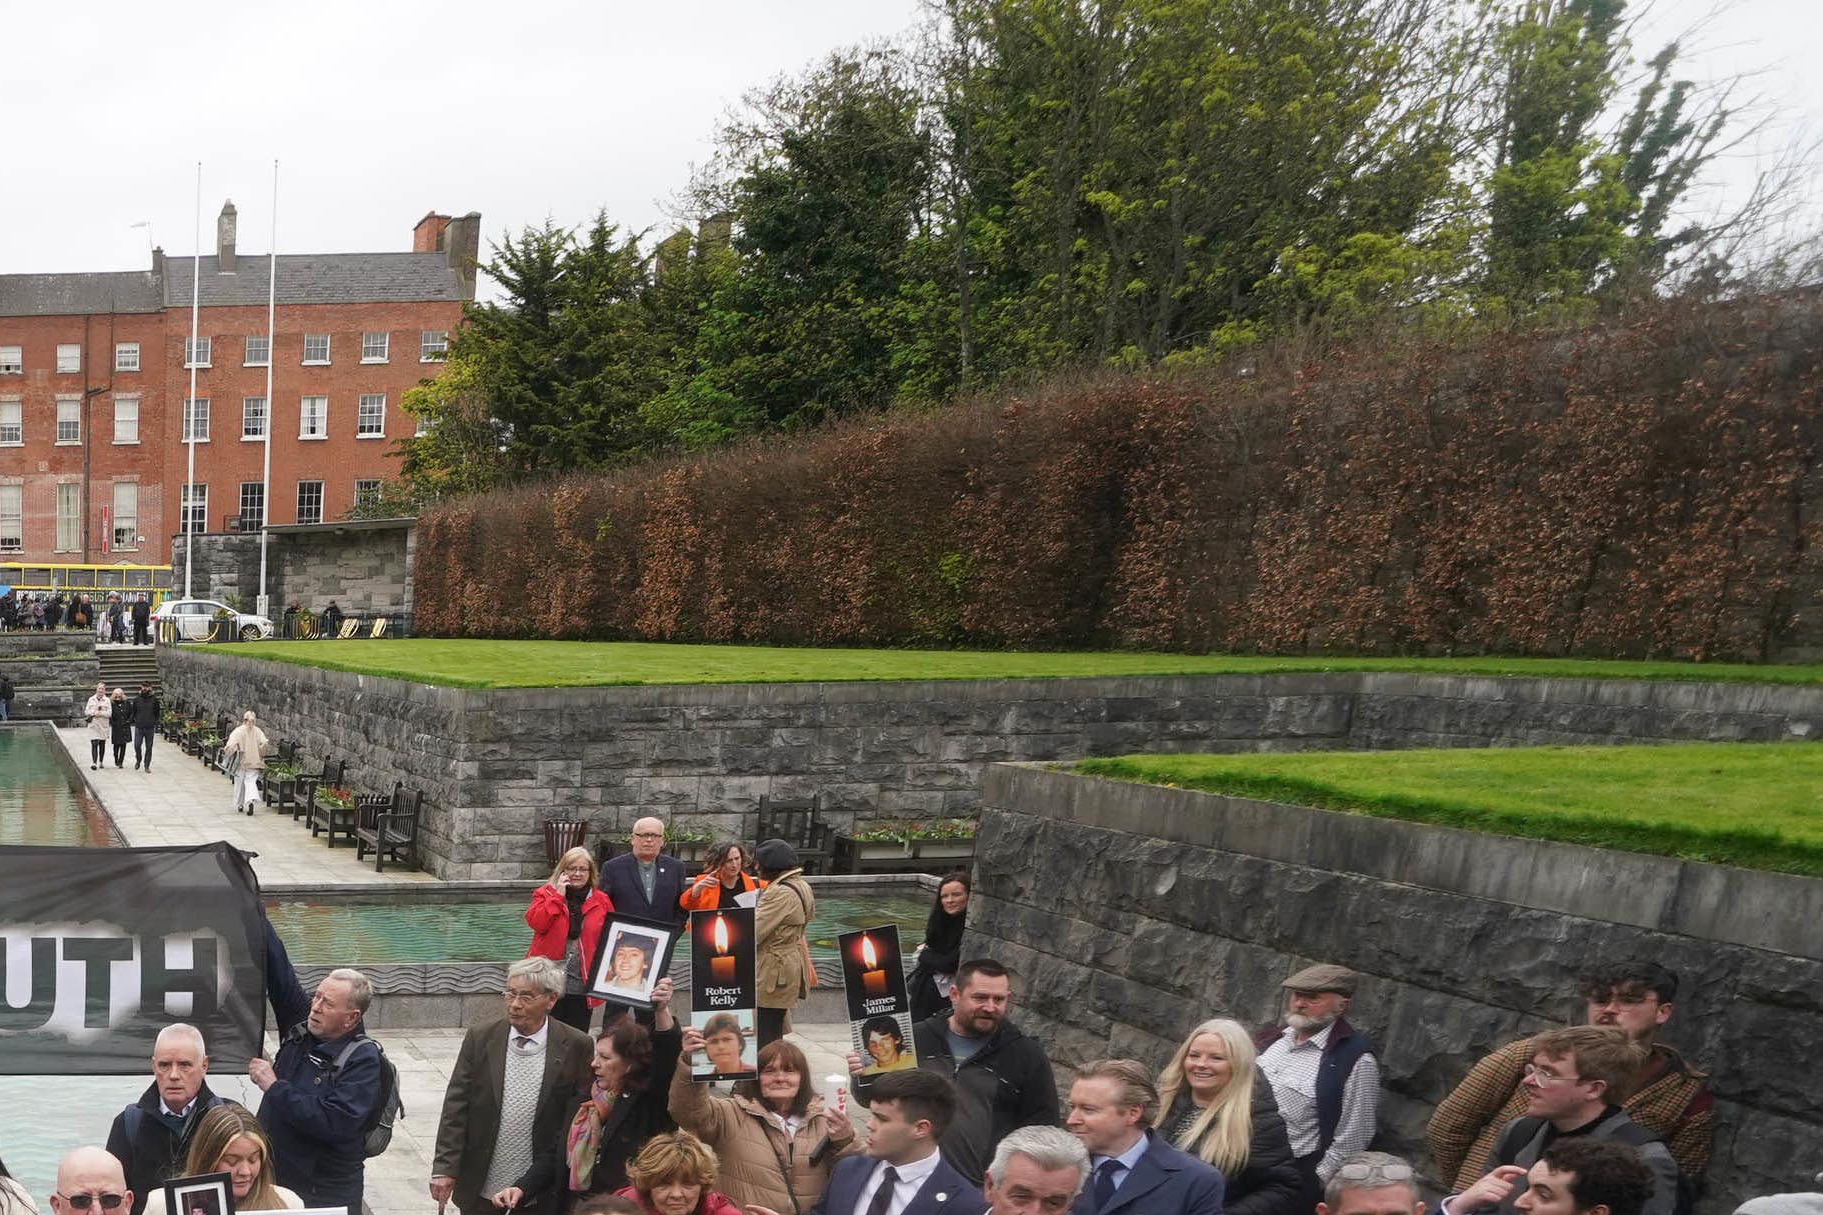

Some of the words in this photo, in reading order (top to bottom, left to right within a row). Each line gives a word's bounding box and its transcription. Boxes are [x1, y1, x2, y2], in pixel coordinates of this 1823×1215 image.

[705, 986, 741, 996] Robert
[710, 995, 738, 1006] Kelly
[862, 996, 896, 1008] James
[866, 1003, 896, 1015] Millar
